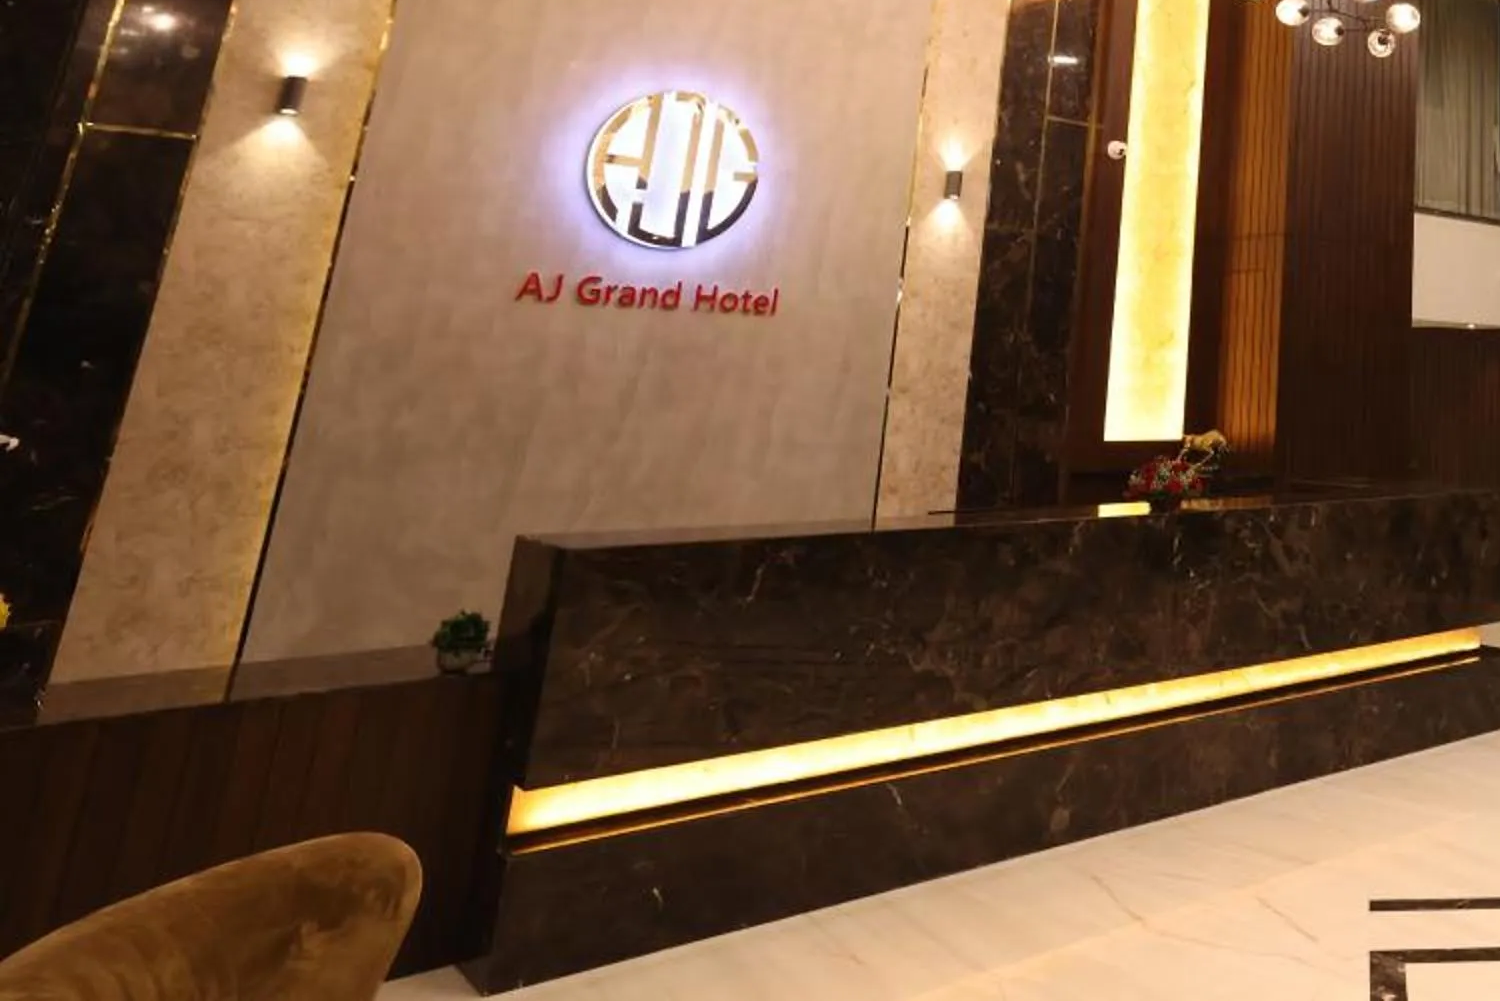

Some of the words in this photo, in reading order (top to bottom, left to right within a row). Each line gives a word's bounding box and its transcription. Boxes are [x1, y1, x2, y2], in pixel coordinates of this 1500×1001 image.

[515, 272, 563, 304] AJ
[576, 276, 683, 311] Grand
[693, 283, 779, 317] Hotel
